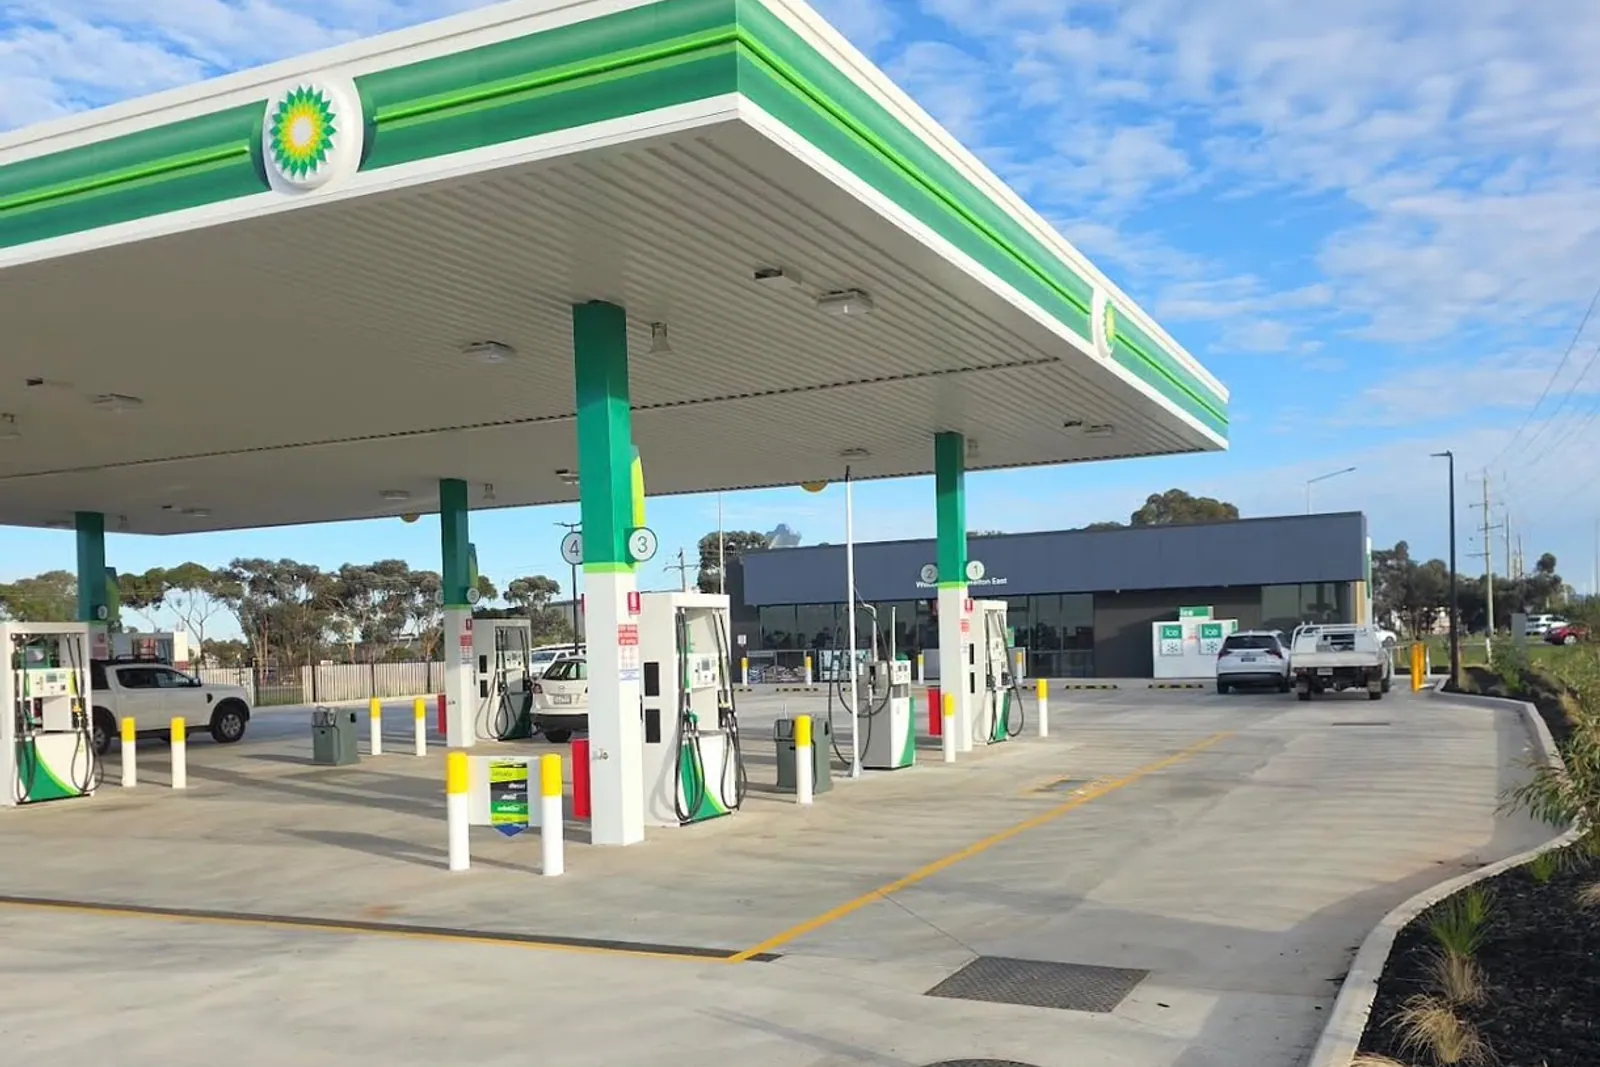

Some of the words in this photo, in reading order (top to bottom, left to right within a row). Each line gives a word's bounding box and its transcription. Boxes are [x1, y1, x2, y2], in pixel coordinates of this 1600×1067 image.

[569, 539, 580, 556] 4
[637, 536, 647, 553] 3
[926, 568, 933, 579] 2
